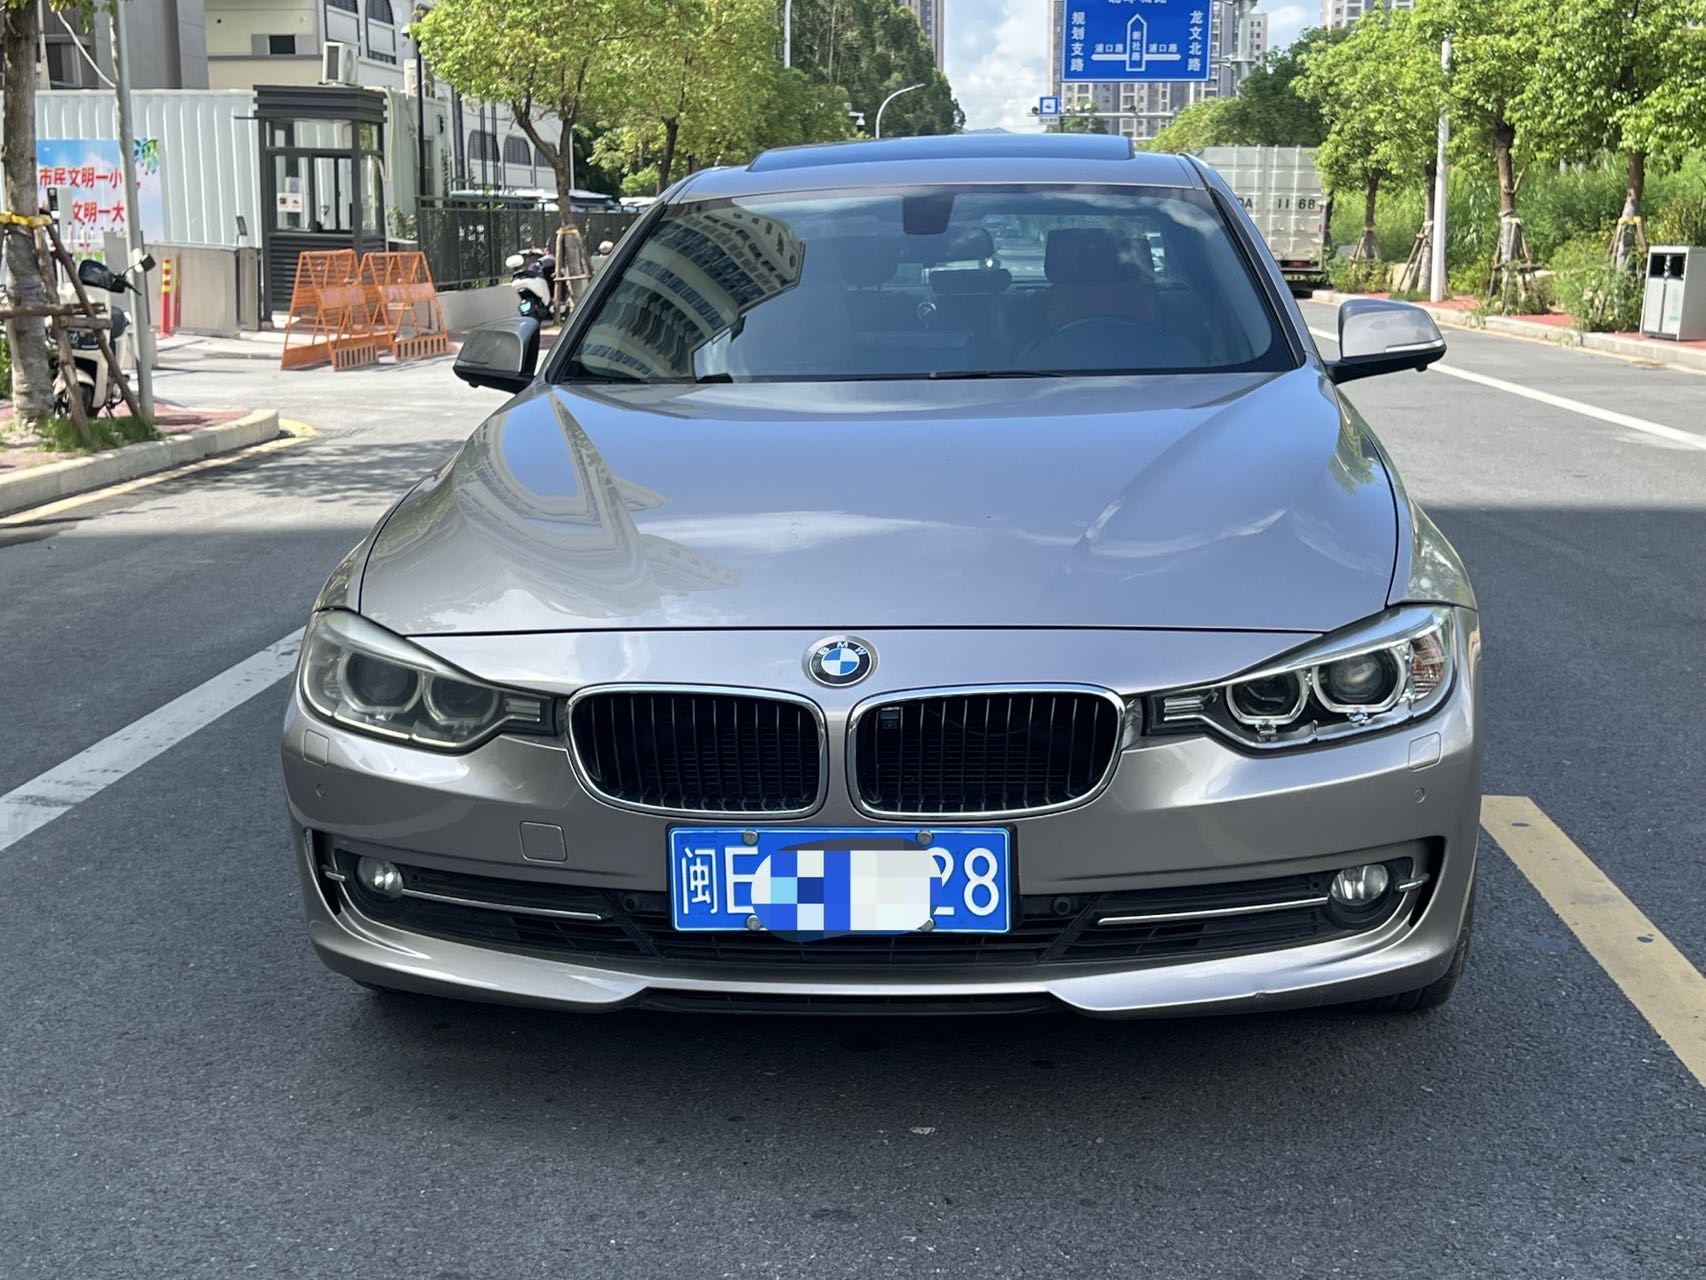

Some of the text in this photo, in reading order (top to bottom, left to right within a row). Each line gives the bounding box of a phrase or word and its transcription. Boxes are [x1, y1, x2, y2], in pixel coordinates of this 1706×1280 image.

[1070, 11, 1086, 72] 规划支路
[1187, 10, 1204, 72] 龙文北路
[39, 166, 141, 191] 市民文明一小，
[817, 641, 867, 656] BMW
[681, 846, 1000, 917] 闽E28
